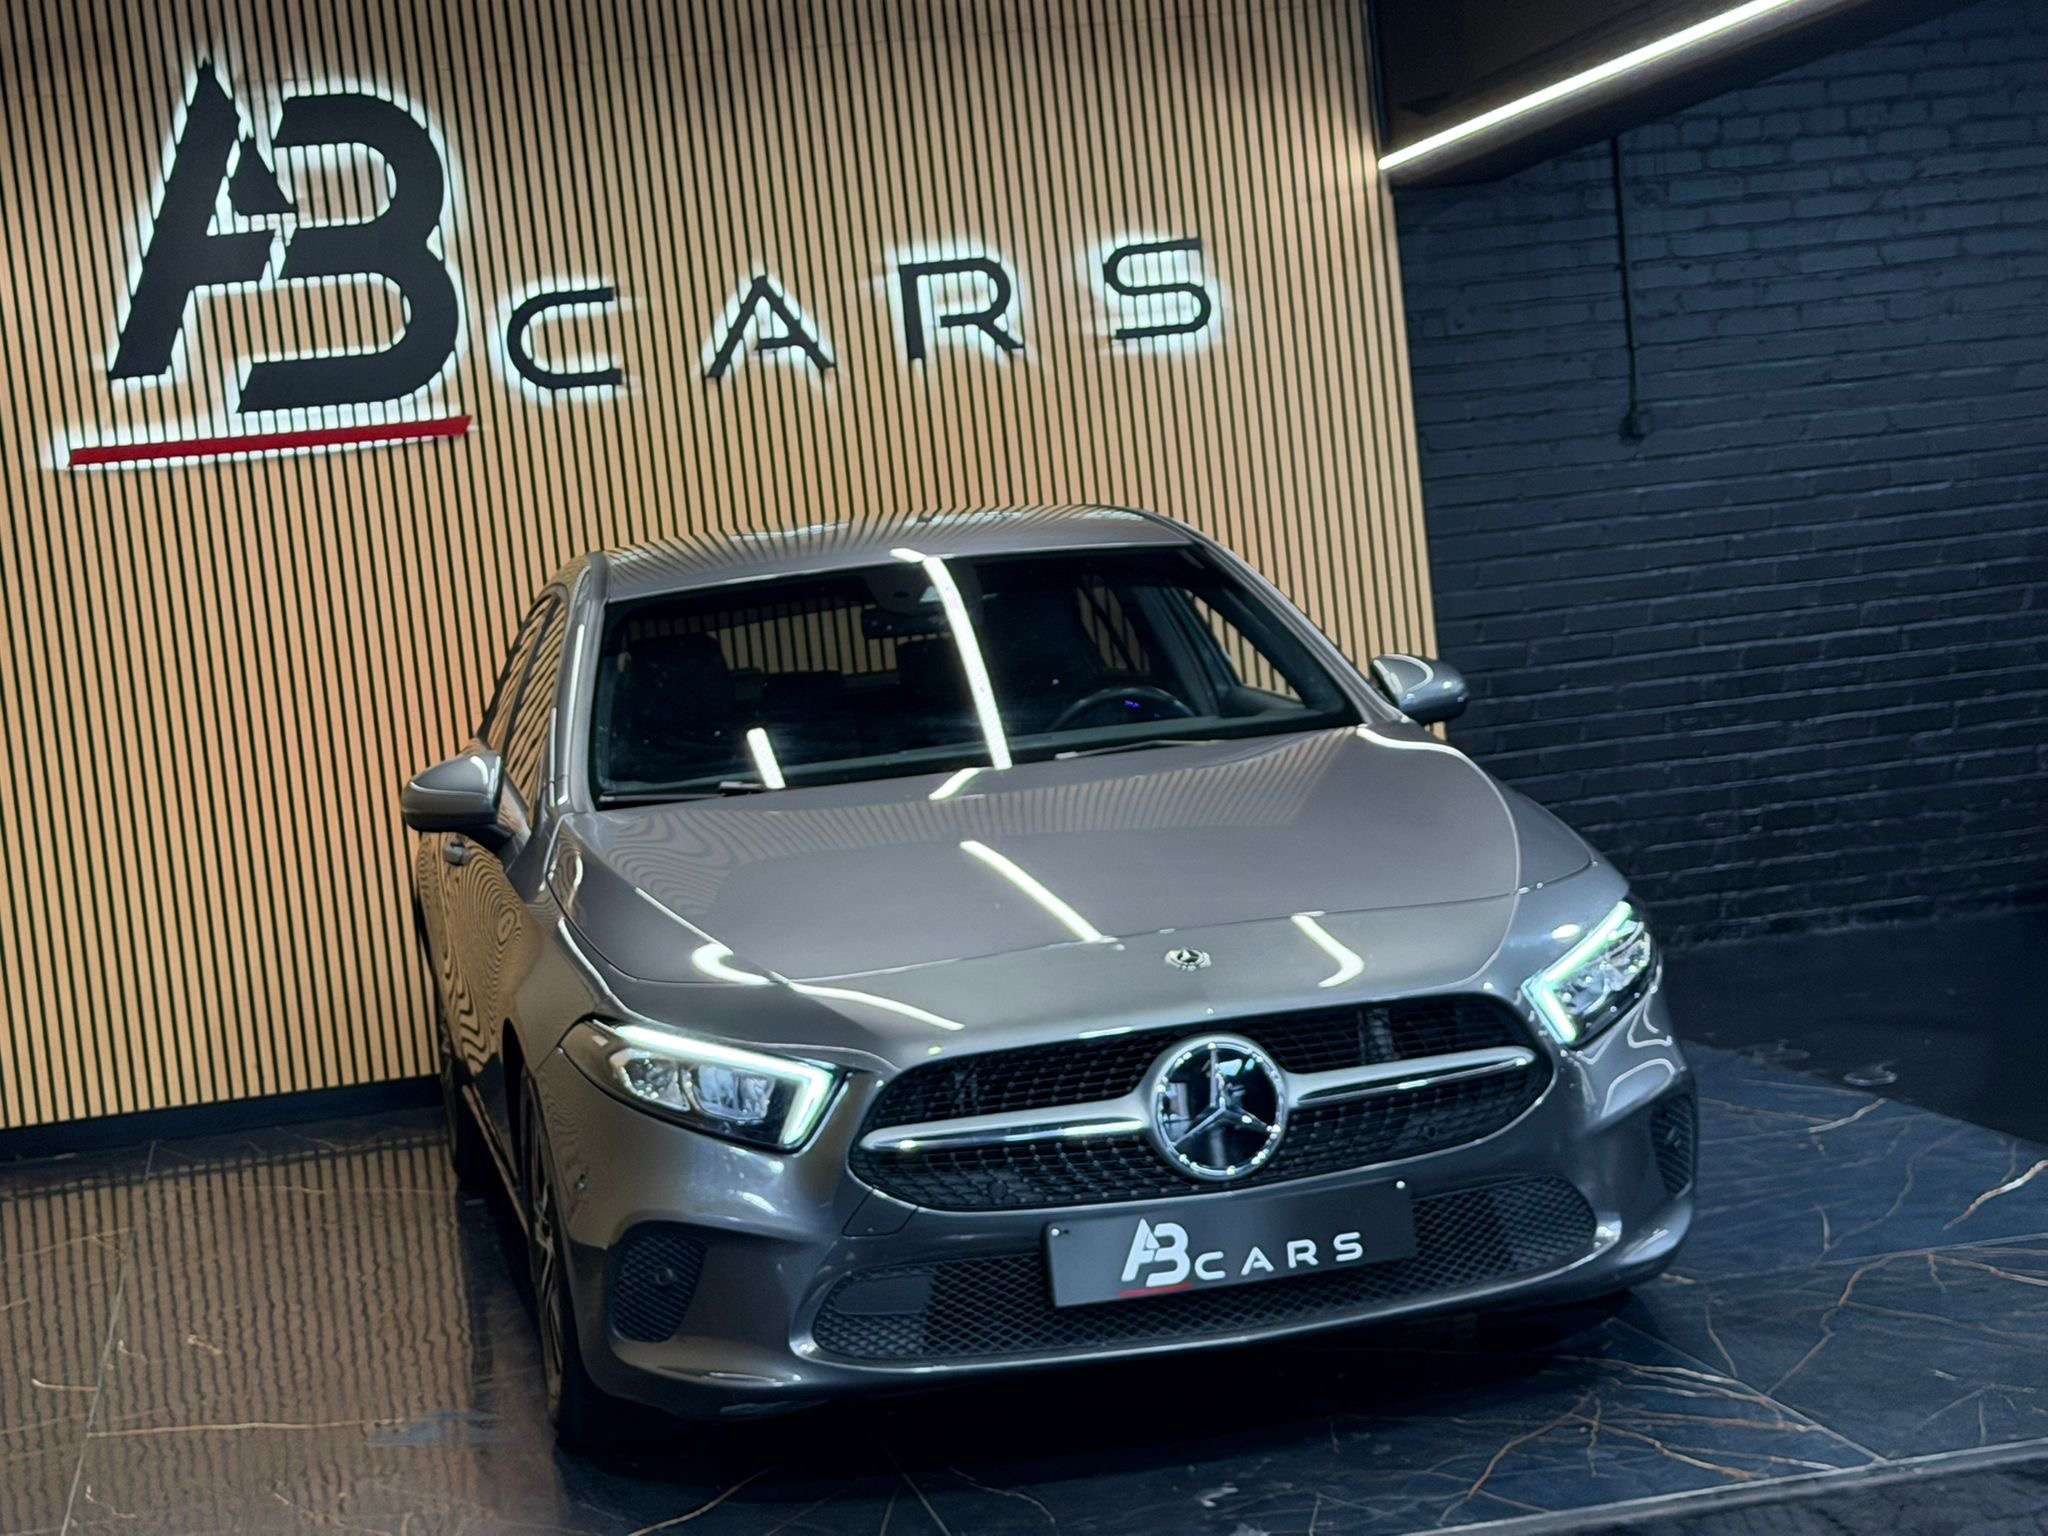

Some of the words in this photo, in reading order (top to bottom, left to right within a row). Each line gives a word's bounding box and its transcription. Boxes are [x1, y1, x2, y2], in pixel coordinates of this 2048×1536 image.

[108, 58, 459, 413] AB
[505, 237, 1213, 390] CARS
[1120, 1218, 1191, 1287] AB
[1194, 1231, 1364, 1281] CARS
